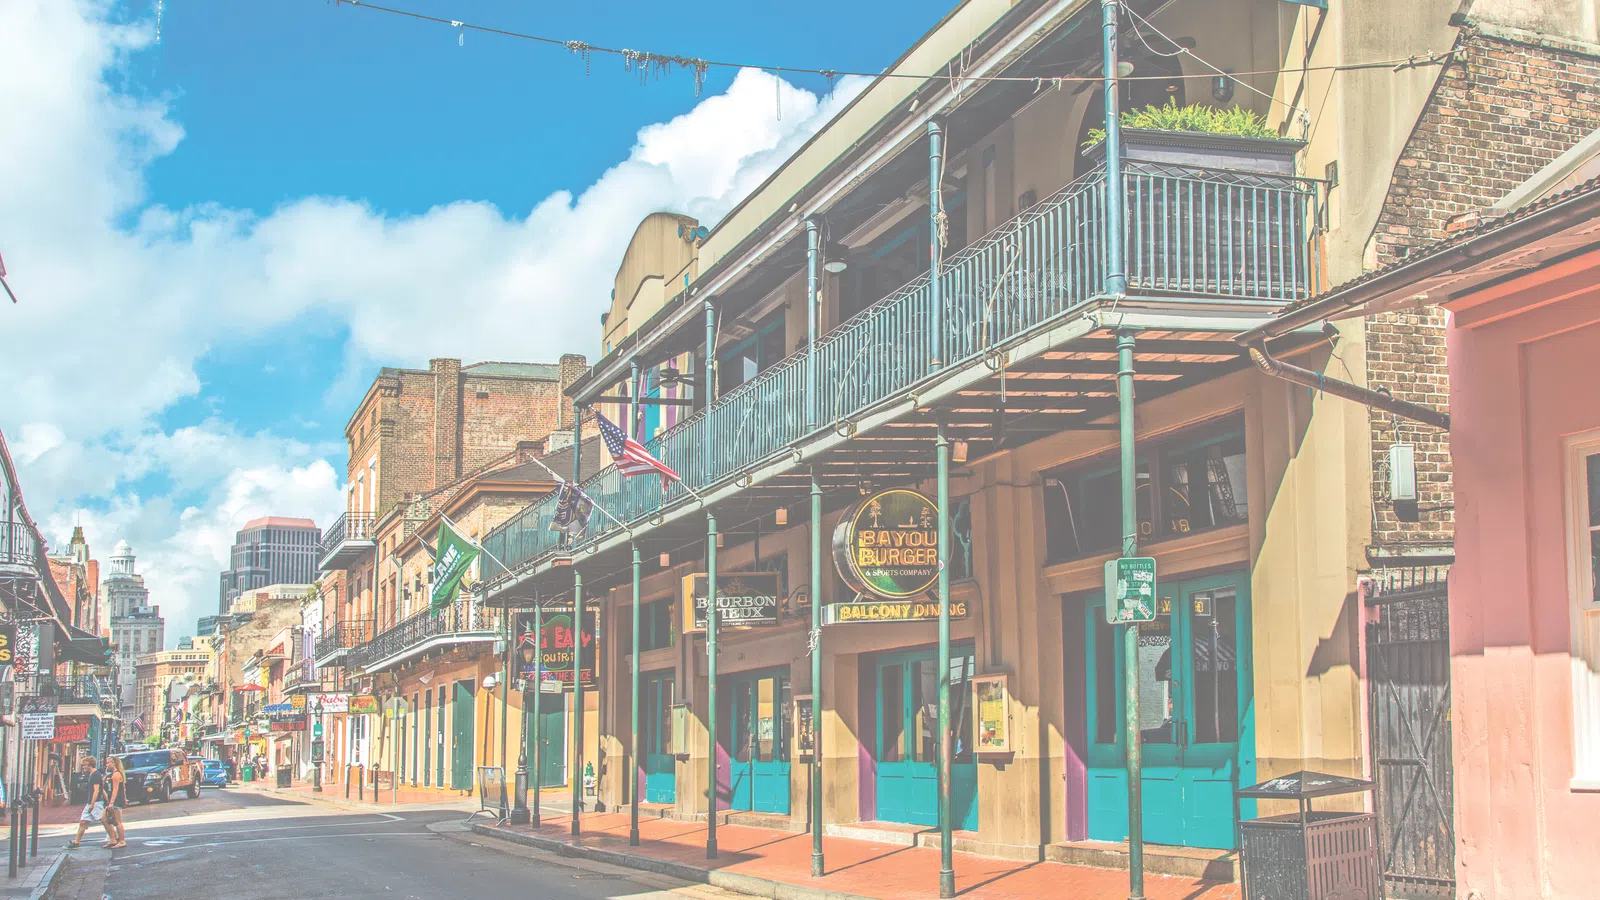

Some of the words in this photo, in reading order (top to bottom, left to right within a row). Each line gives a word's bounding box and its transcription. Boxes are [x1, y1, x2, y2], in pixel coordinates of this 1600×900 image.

[859, 529, 938, 547] BAYOU
[859, 548, 938, 566] BURGER
[865, 569, 872, 577] &
[873, 568, 899, 577] SPORTS
[900, 568, 932, 576] COMPANY
[840, 604, 912, 620] BALCONY
[913, 603, 967, 617] DINNG
[554, 626, 592, 649] EAY
[554, 671, 569, 681] THE
[570, 670, 592, 681] SICE
